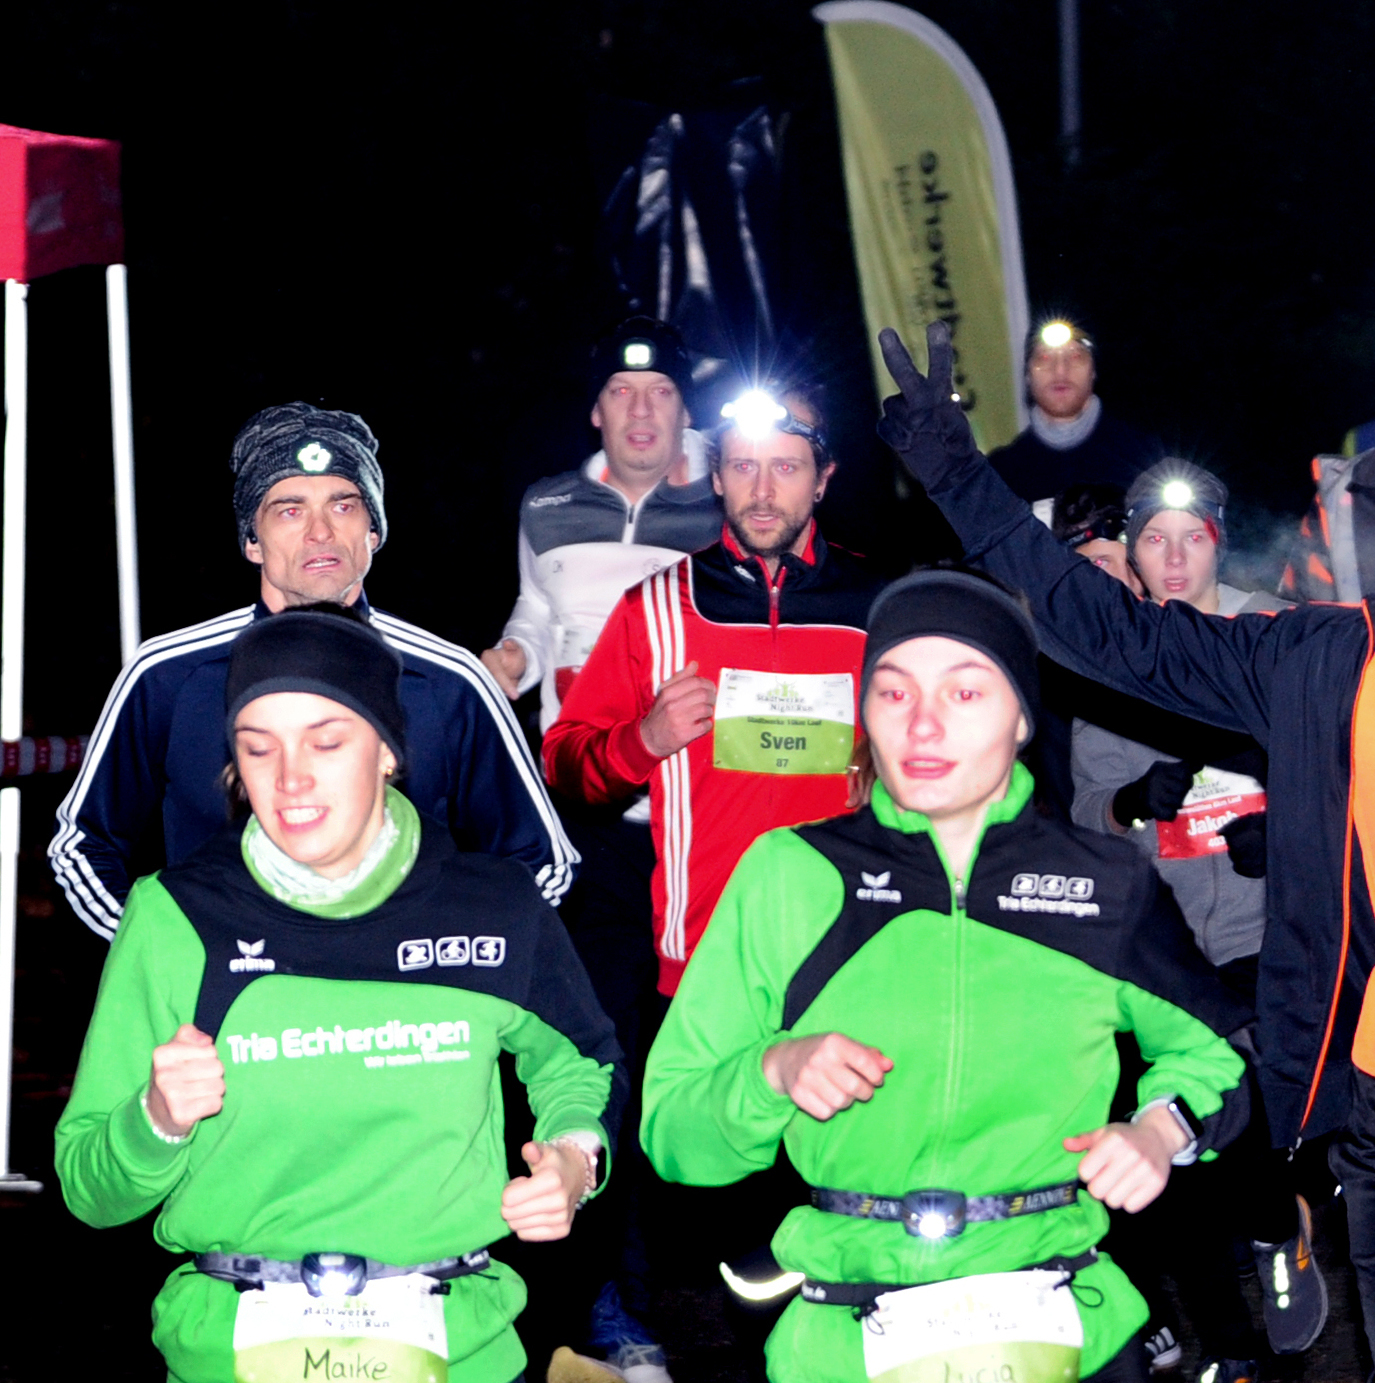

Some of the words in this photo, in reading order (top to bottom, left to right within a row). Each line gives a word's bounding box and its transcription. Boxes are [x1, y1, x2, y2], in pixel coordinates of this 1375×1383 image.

[760, 731, 807, 750] Sven
[776, 758, 789, 768] 87
[229, 957, 276, 973] erima
[226, 1032, 278, 1064] Tria
[281, 1019, 471, 1059] Echterdingen
[303, 1346, 391, 1380] Maike
